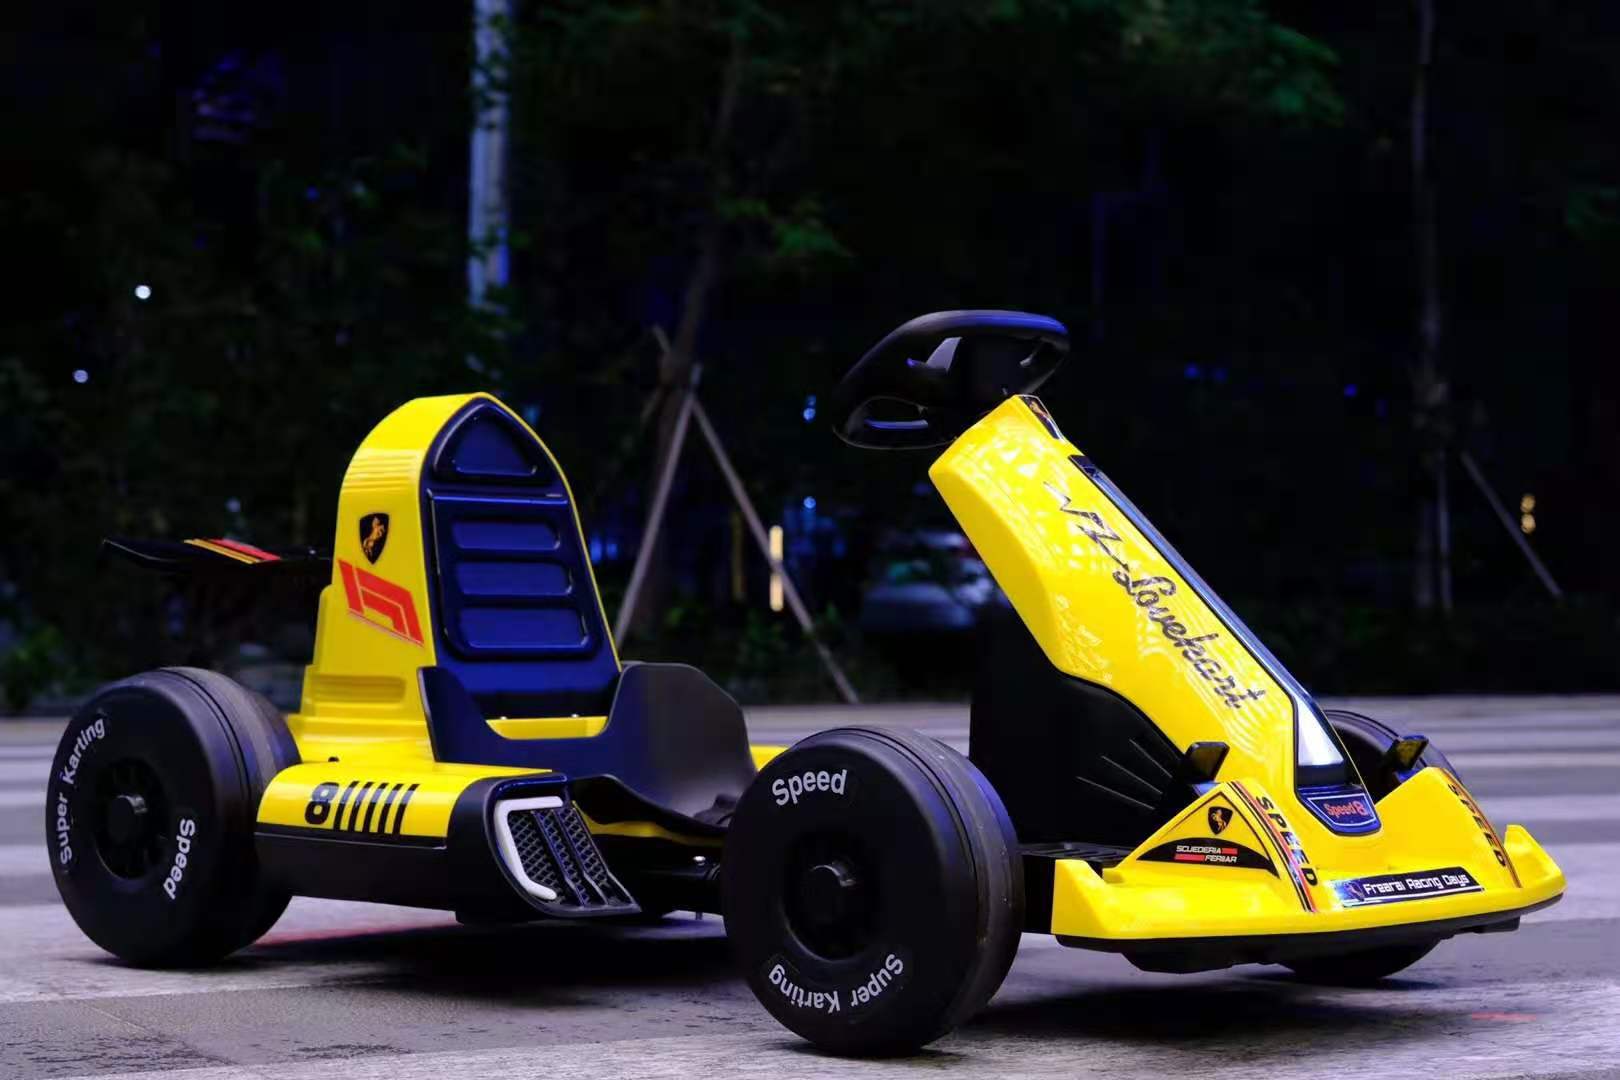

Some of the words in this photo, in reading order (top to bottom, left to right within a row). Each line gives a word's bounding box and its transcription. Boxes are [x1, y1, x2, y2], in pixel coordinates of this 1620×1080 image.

[63, 717, 106, 785] Karting
[772, 769, 848, 806] Speed
[59, 792, 74, 866] Super
[163, 817, 196, 899] Speed
[1256, 796, 1318, 886] SPEED
[1406, 876, 1444, 890] Racing
[1441, 873, 1471, 887] Days
[768, 963, 841, 1014] Karting
[850, 953, 904, 1008] Super
